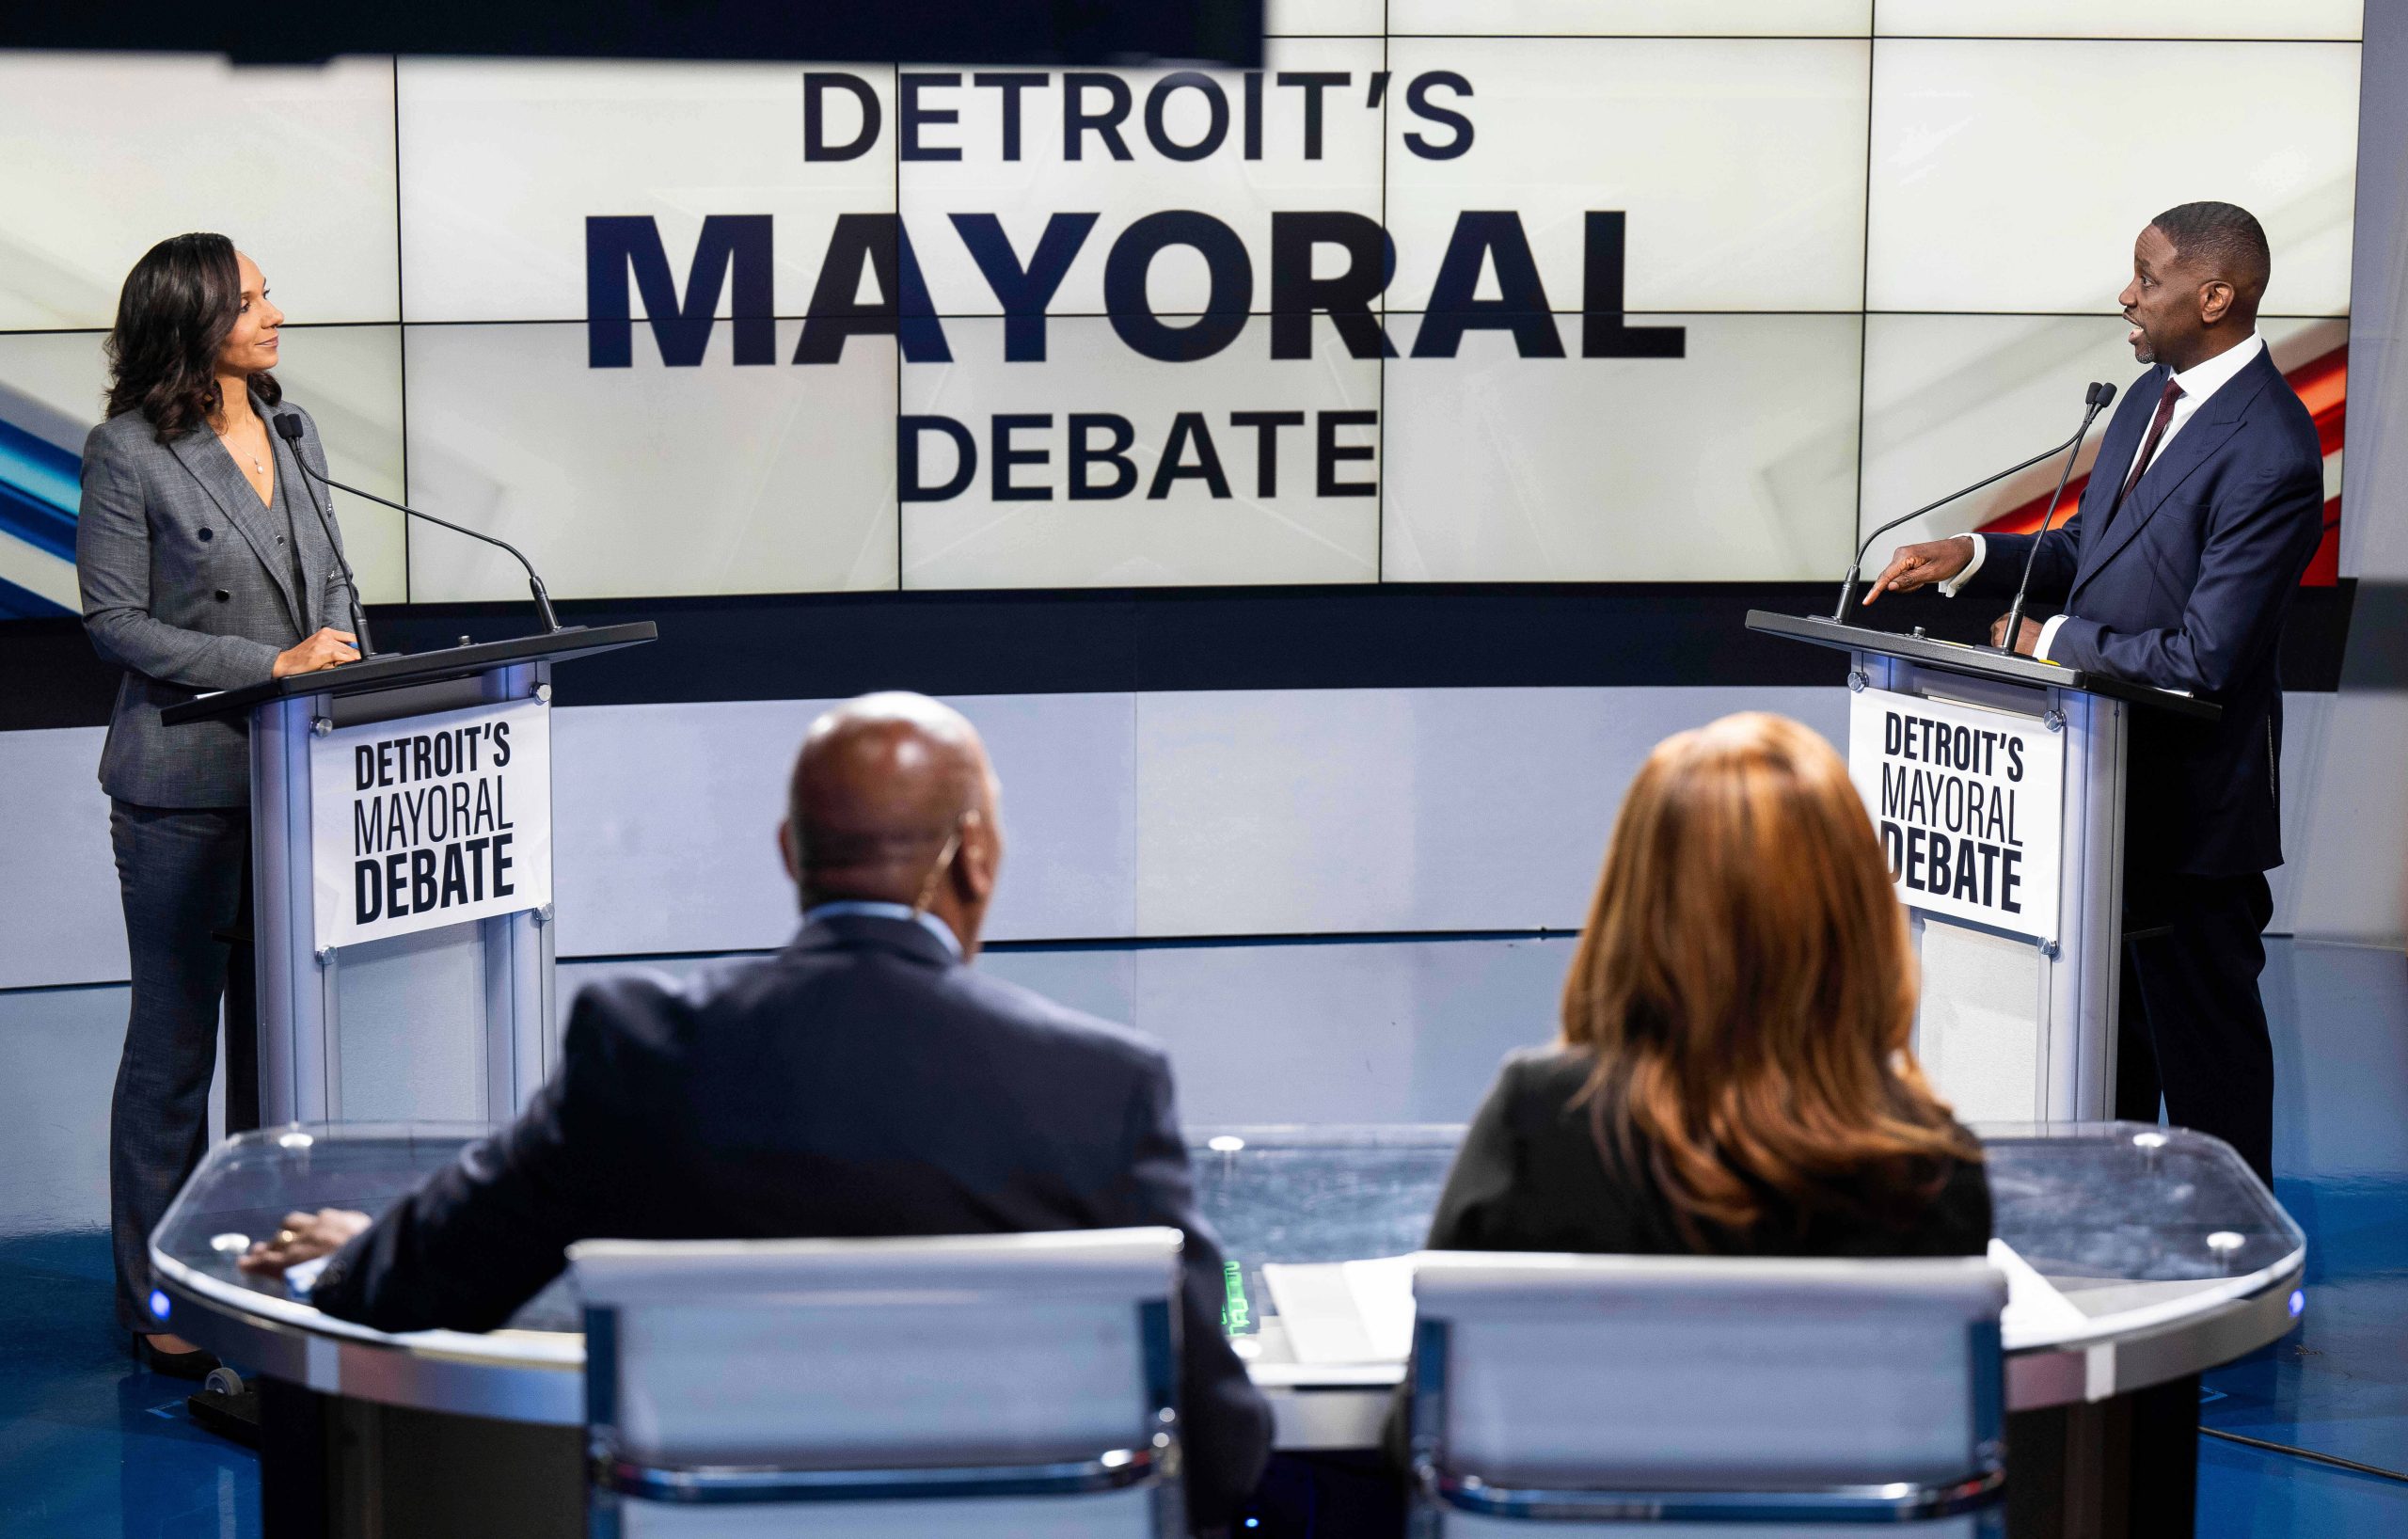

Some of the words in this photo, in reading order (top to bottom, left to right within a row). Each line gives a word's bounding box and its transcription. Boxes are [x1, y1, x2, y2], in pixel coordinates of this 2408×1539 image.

[803, 70, 1474, 161] DETROIT'S
[585, 209, 1687, 368] MAYORAL
[897, 409, 1377, 502] DEBATE
[355, 722, 511, 791] DETROIT'S
[1885, 711, 2024, 783] DETROIT'S
[354, 774, 514, 856] MAYORAL
[1881, 761, 2023, 847] MAYORAL
[355, 833, 515, 926] DEBATE
[1880, 819, 2022, 914] DEBATE
